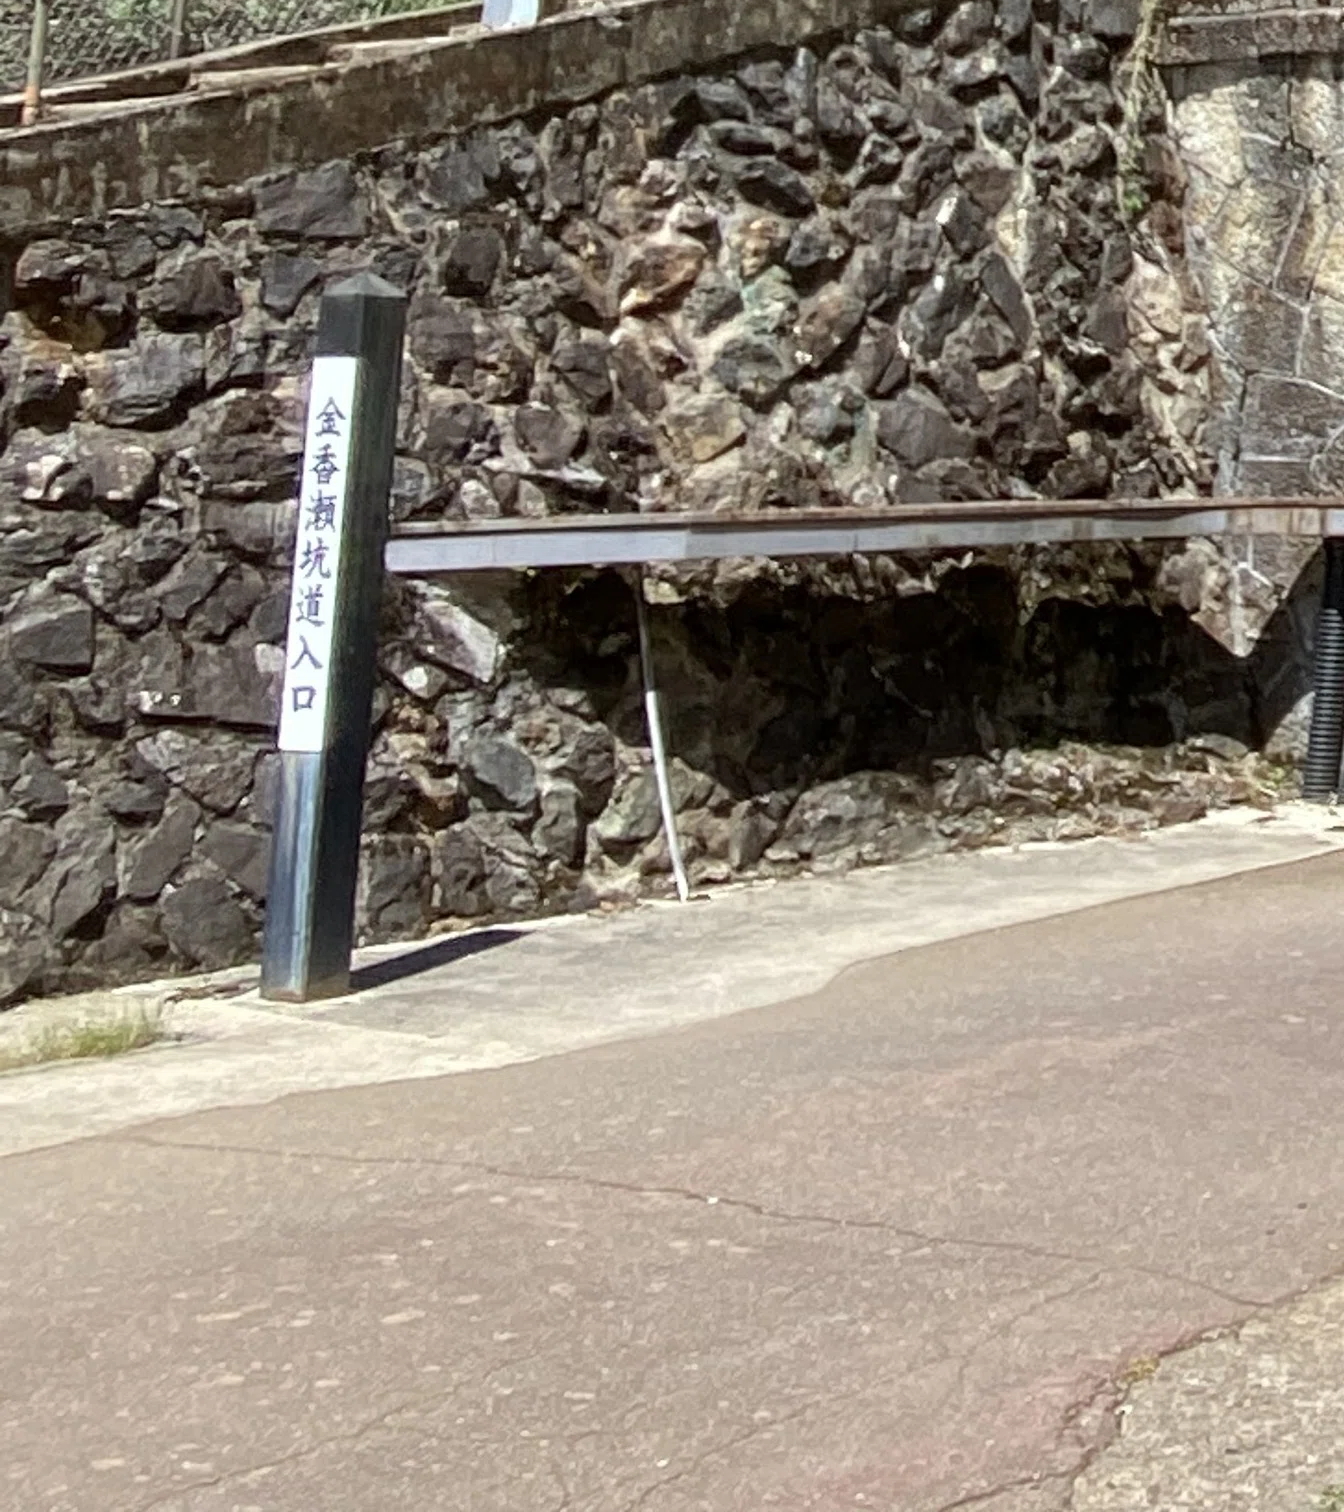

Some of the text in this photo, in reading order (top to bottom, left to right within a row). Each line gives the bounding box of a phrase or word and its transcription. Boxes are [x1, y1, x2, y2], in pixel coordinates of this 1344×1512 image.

[290, 396, 347, 713] 金香瀬坑道入口
